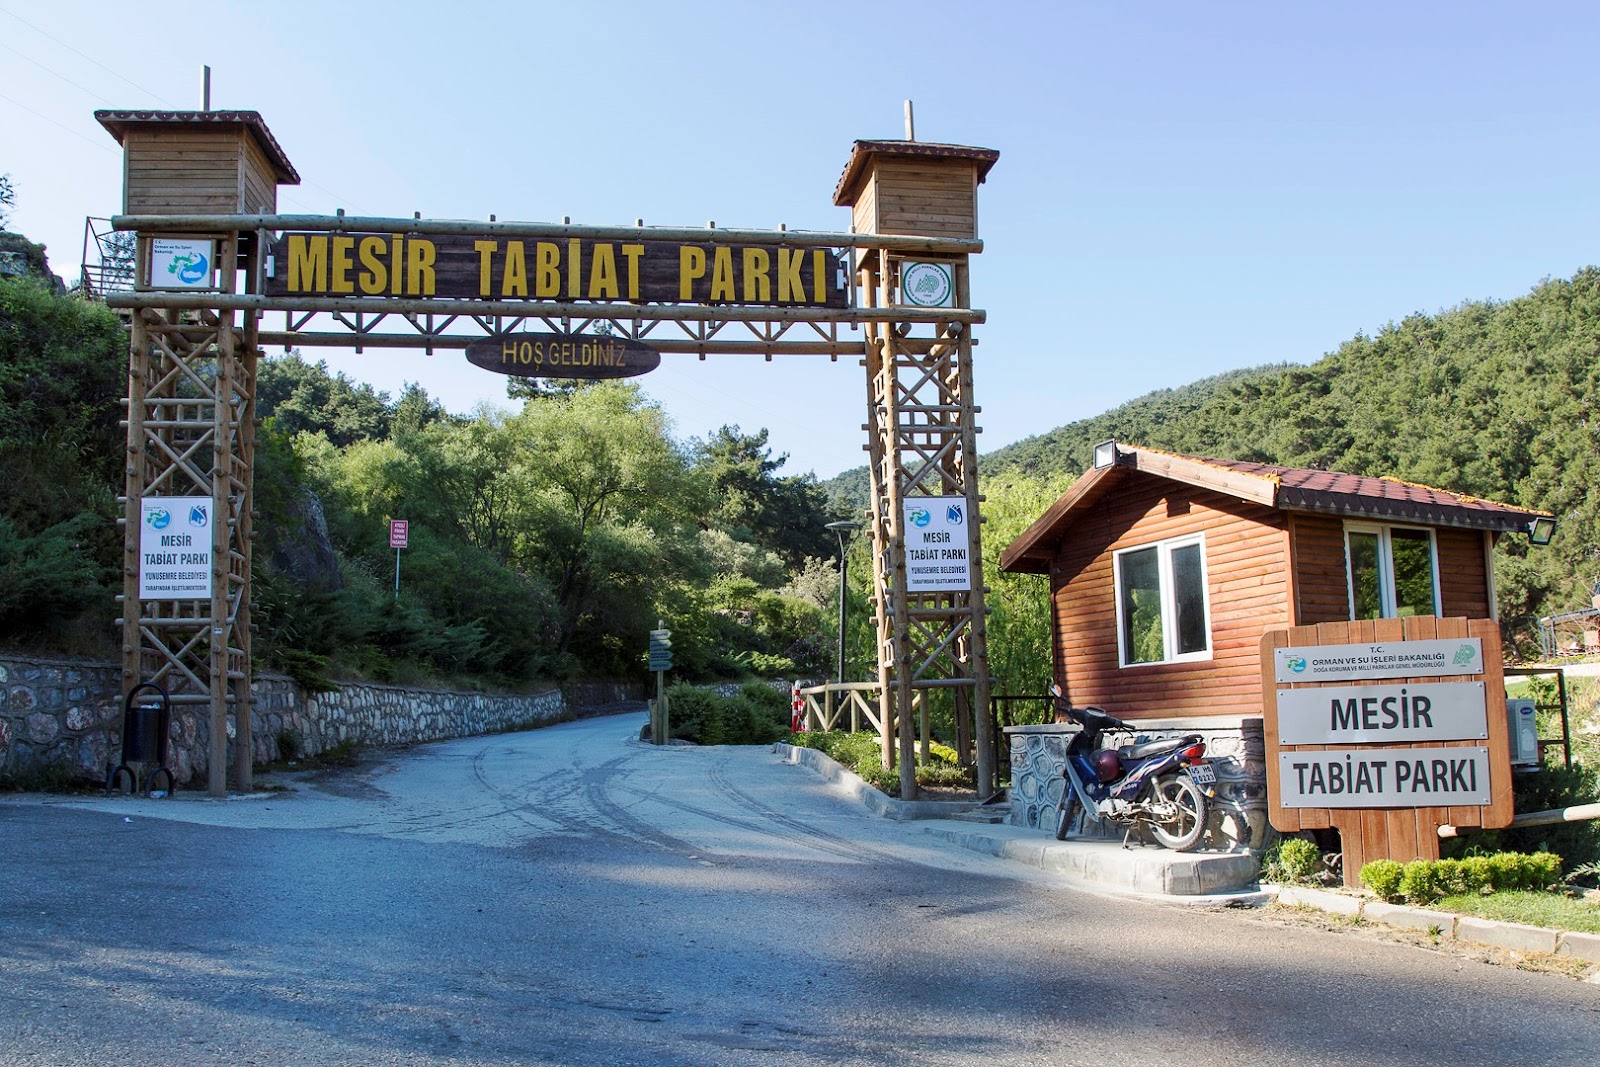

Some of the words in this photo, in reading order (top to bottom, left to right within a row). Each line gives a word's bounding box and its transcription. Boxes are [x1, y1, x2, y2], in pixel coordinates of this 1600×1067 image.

[287, 233, 437, 296] MESİR
[474, 237, 645, 299] TABİAT
[679, 245, 827, 304] PARKI
[502, 341, 544, 371] HOŞ
[549, 338, 627, 367] GELDİNİZ
[161, 533, 192, 547] MESİR
[923, 530, 951, 543] MESİR
[145, 551, 177, 565] TABİAT
[180, 553, 208, 565] PARKI
[909, 547, 939, 560] TABİAT
[941, 549, 966, 560] PARKI
[145, 572, 177, 580] YUNUSEMRE
[178, 570, 208, 580] BELEDİYESİ
[911, 566, 940, 574] YUNUSEMRE
[940, 565, 967, 574] BELEDİYESİ
[1312, 658, 1344, 666] ORMAN
[1357, 656, 1369, 664] SU
[1371, 654, 1396, 664] İŞLERİ
[1398, 652, 1445, 662] BAKANLIĞI
[1412, 661, 1445, 669] MÜDÜRLÜĞÜ
[1331, 688, 1433, 731] MESİR
[1293, 753, 1387, 795] TABİAT
[1395, 759, 1477, 793] PARKI
